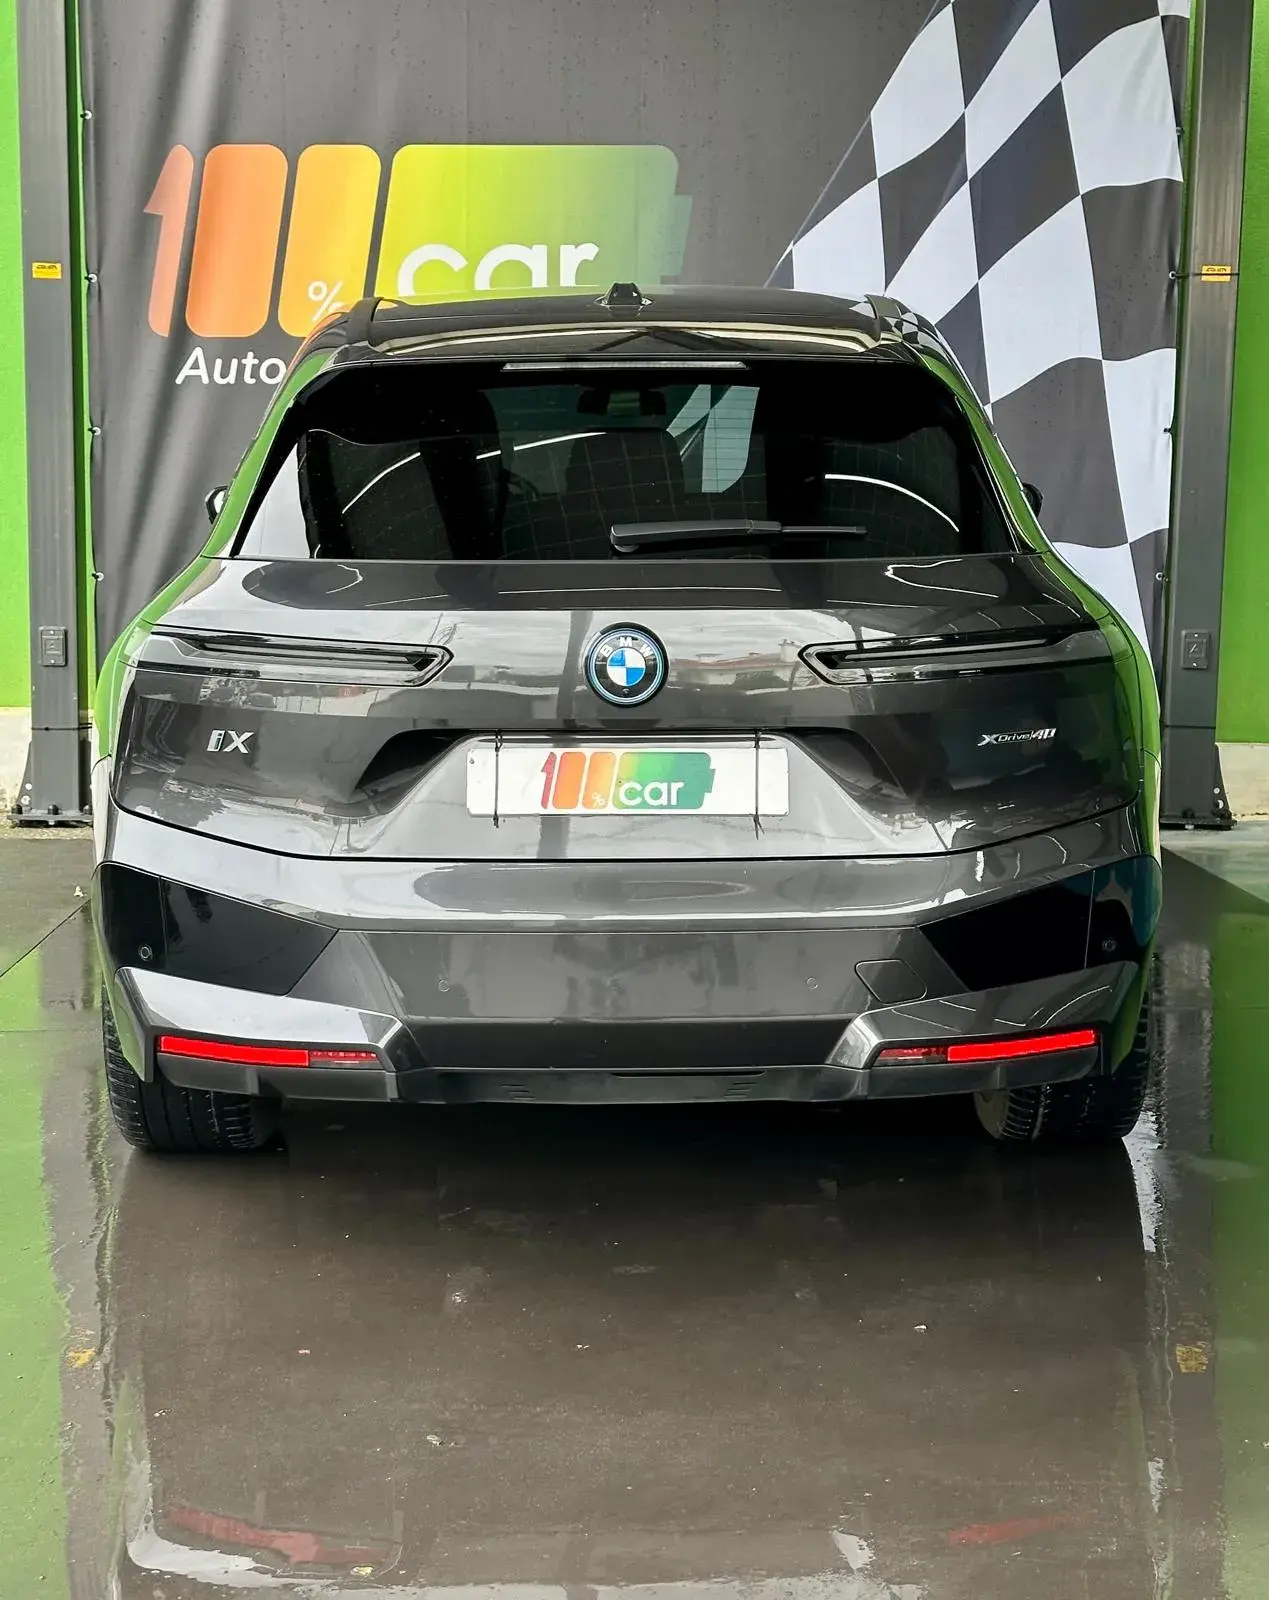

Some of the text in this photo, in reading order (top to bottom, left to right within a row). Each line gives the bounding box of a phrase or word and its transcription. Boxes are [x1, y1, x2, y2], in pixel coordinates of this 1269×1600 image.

[397, 243, 600, 297] car
[175, 346, 287, 385] Auto
[600, 636, 654, 658] BMW
[206, 729, 254, 754] iX
[618, 781, 685, 806] car
